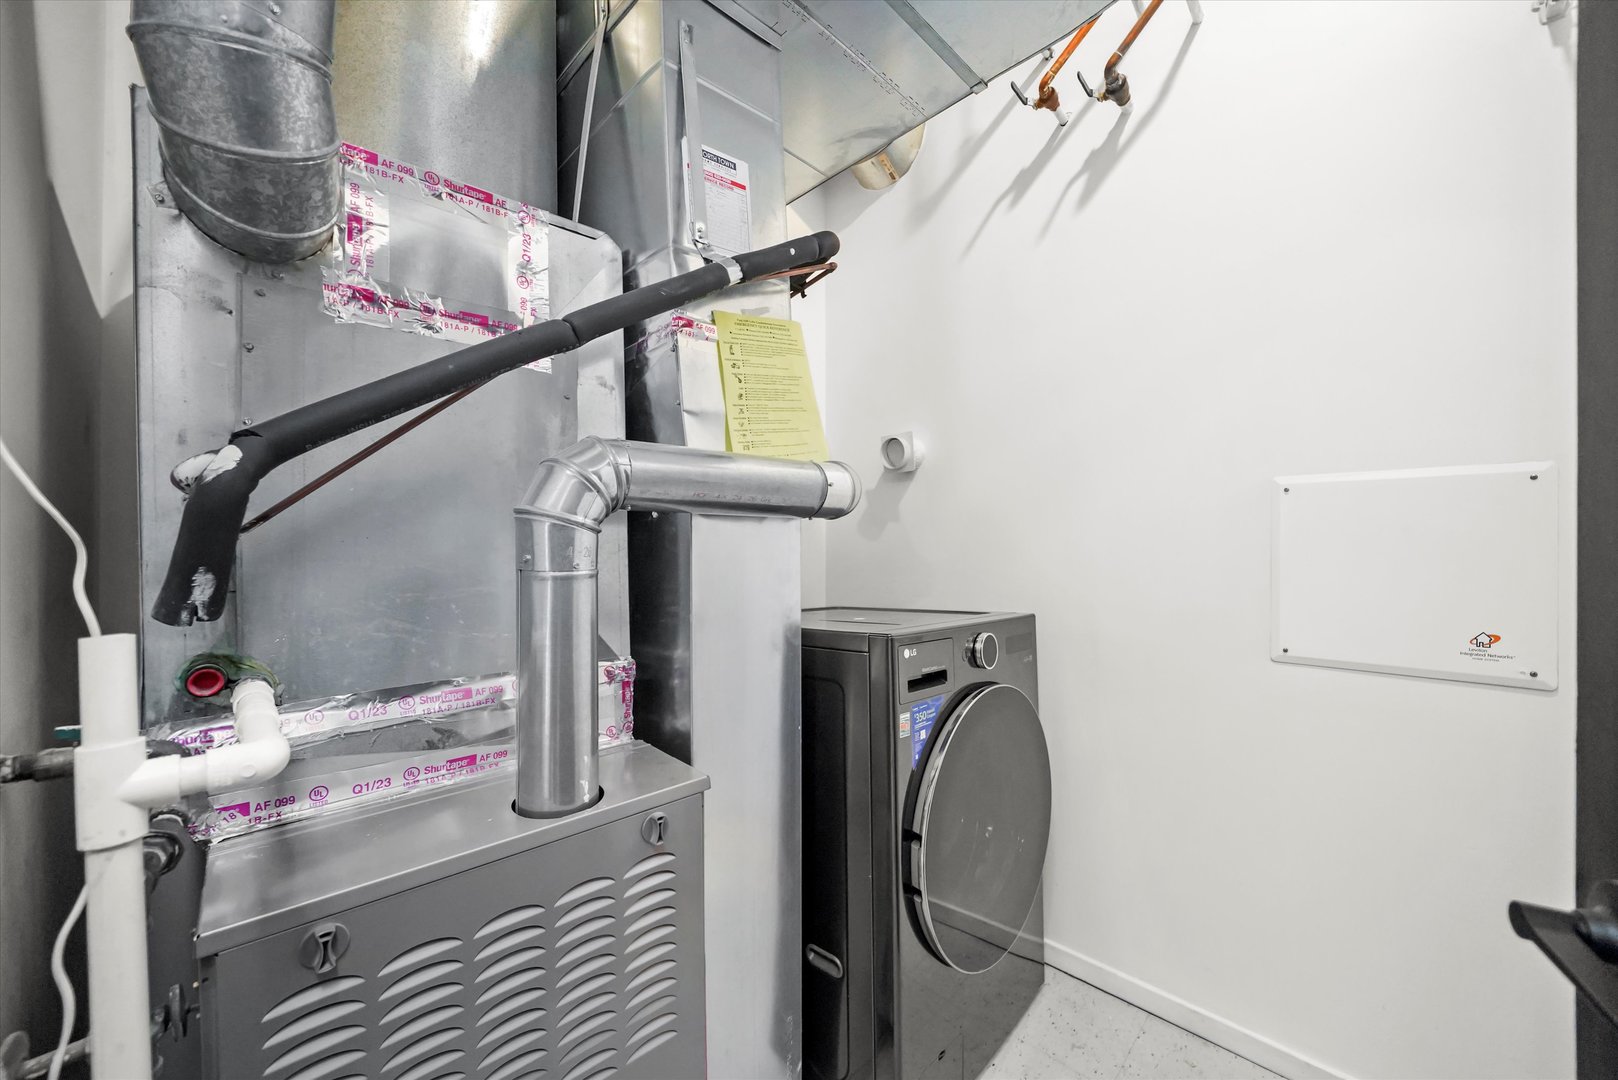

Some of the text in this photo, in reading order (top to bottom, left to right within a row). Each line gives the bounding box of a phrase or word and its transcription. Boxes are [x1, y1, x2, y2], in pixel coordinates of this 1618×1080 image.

[364, 165, 404, 184] 181B-FX
[381, 159, 395, 169] AF
[397, 164, 414, 176] 099
[443, 179, 485, 200] Shurtape
[350, 183, 360, 198] 099
[521, 233, 532, 263] Q1/23
[441, 321, 469, 332] 181A-P
[910, 648, 917, 657] LG
[349, 704, 387, 721] Q1/23
[420, 690, 464, 705] Shurtape
[475, 688, 486, 697] AF
[488, 685, 504, 695] 099
[254, 800, 271, 813] AF
[274, 795, 295, 809] 099
[352, 777, 392, 795] Q1/23
[424, 758, 468, 775] Shurtape
[480, 753, 491, 763] AF
[493, 749, 508, 760] 099
